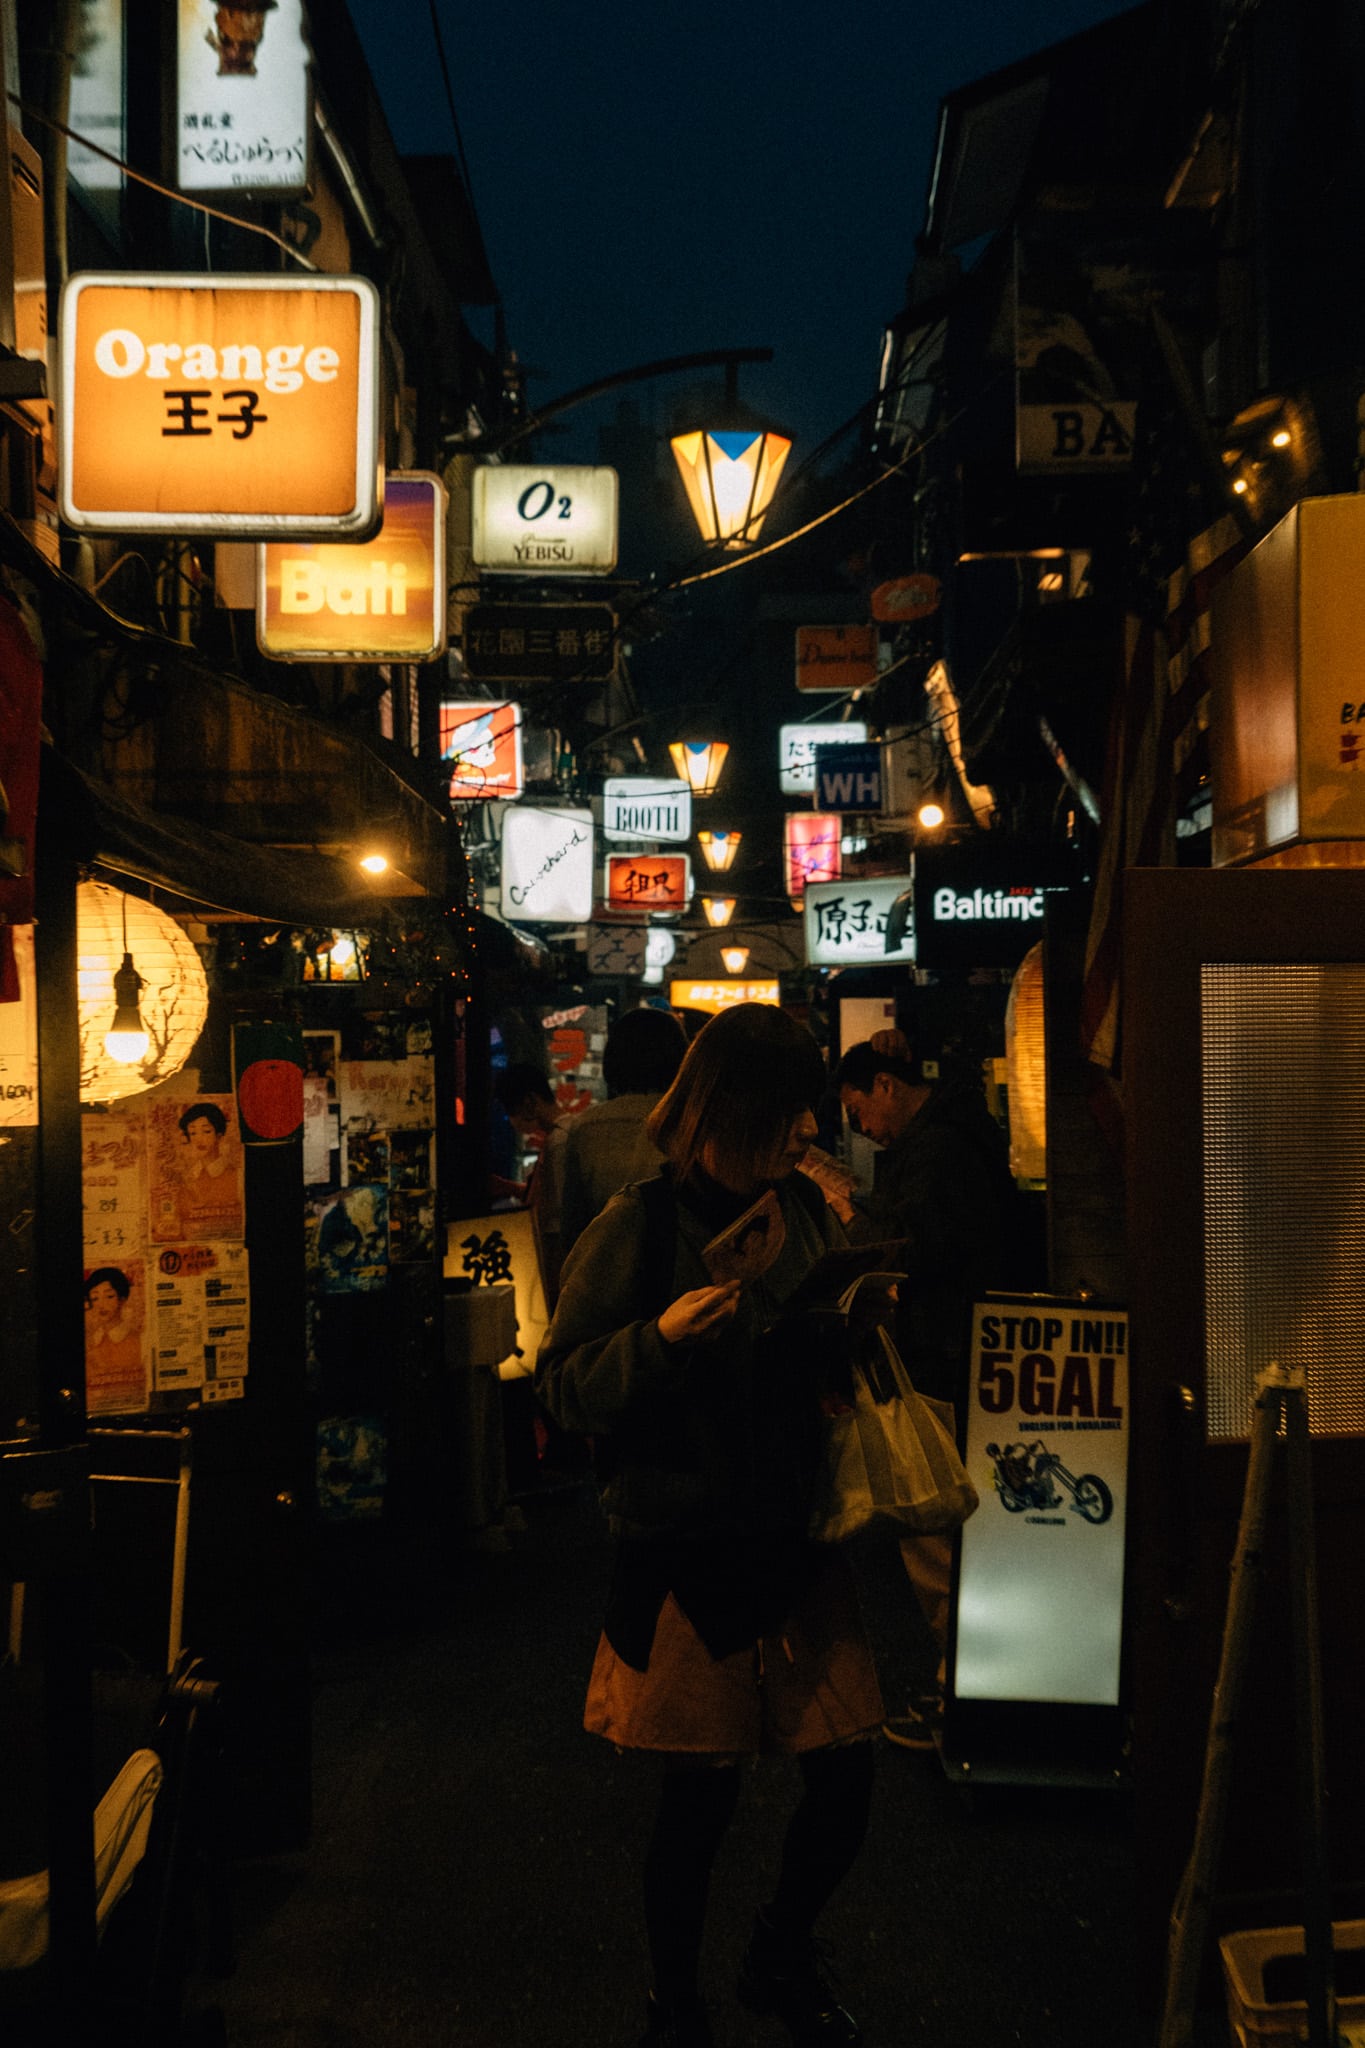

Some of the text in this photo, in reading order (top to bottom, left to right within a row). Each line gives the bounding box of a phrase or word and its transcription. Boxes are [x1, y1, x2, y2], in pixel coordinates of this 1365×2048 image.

[94, 328, 340, 394] Orange
[162, 389, 268, 440] 王子
[513, 544, 574, 561] YEBISU
[280, 560, 407, 616] Bali
[471, 628, 609, 656] 花園三番街
[616, 807, 679, 832] BOOTH
[981, 1316, 1125, 1354] STOP IN!!
[979, 1352, 1122, 1419] 5GAL
